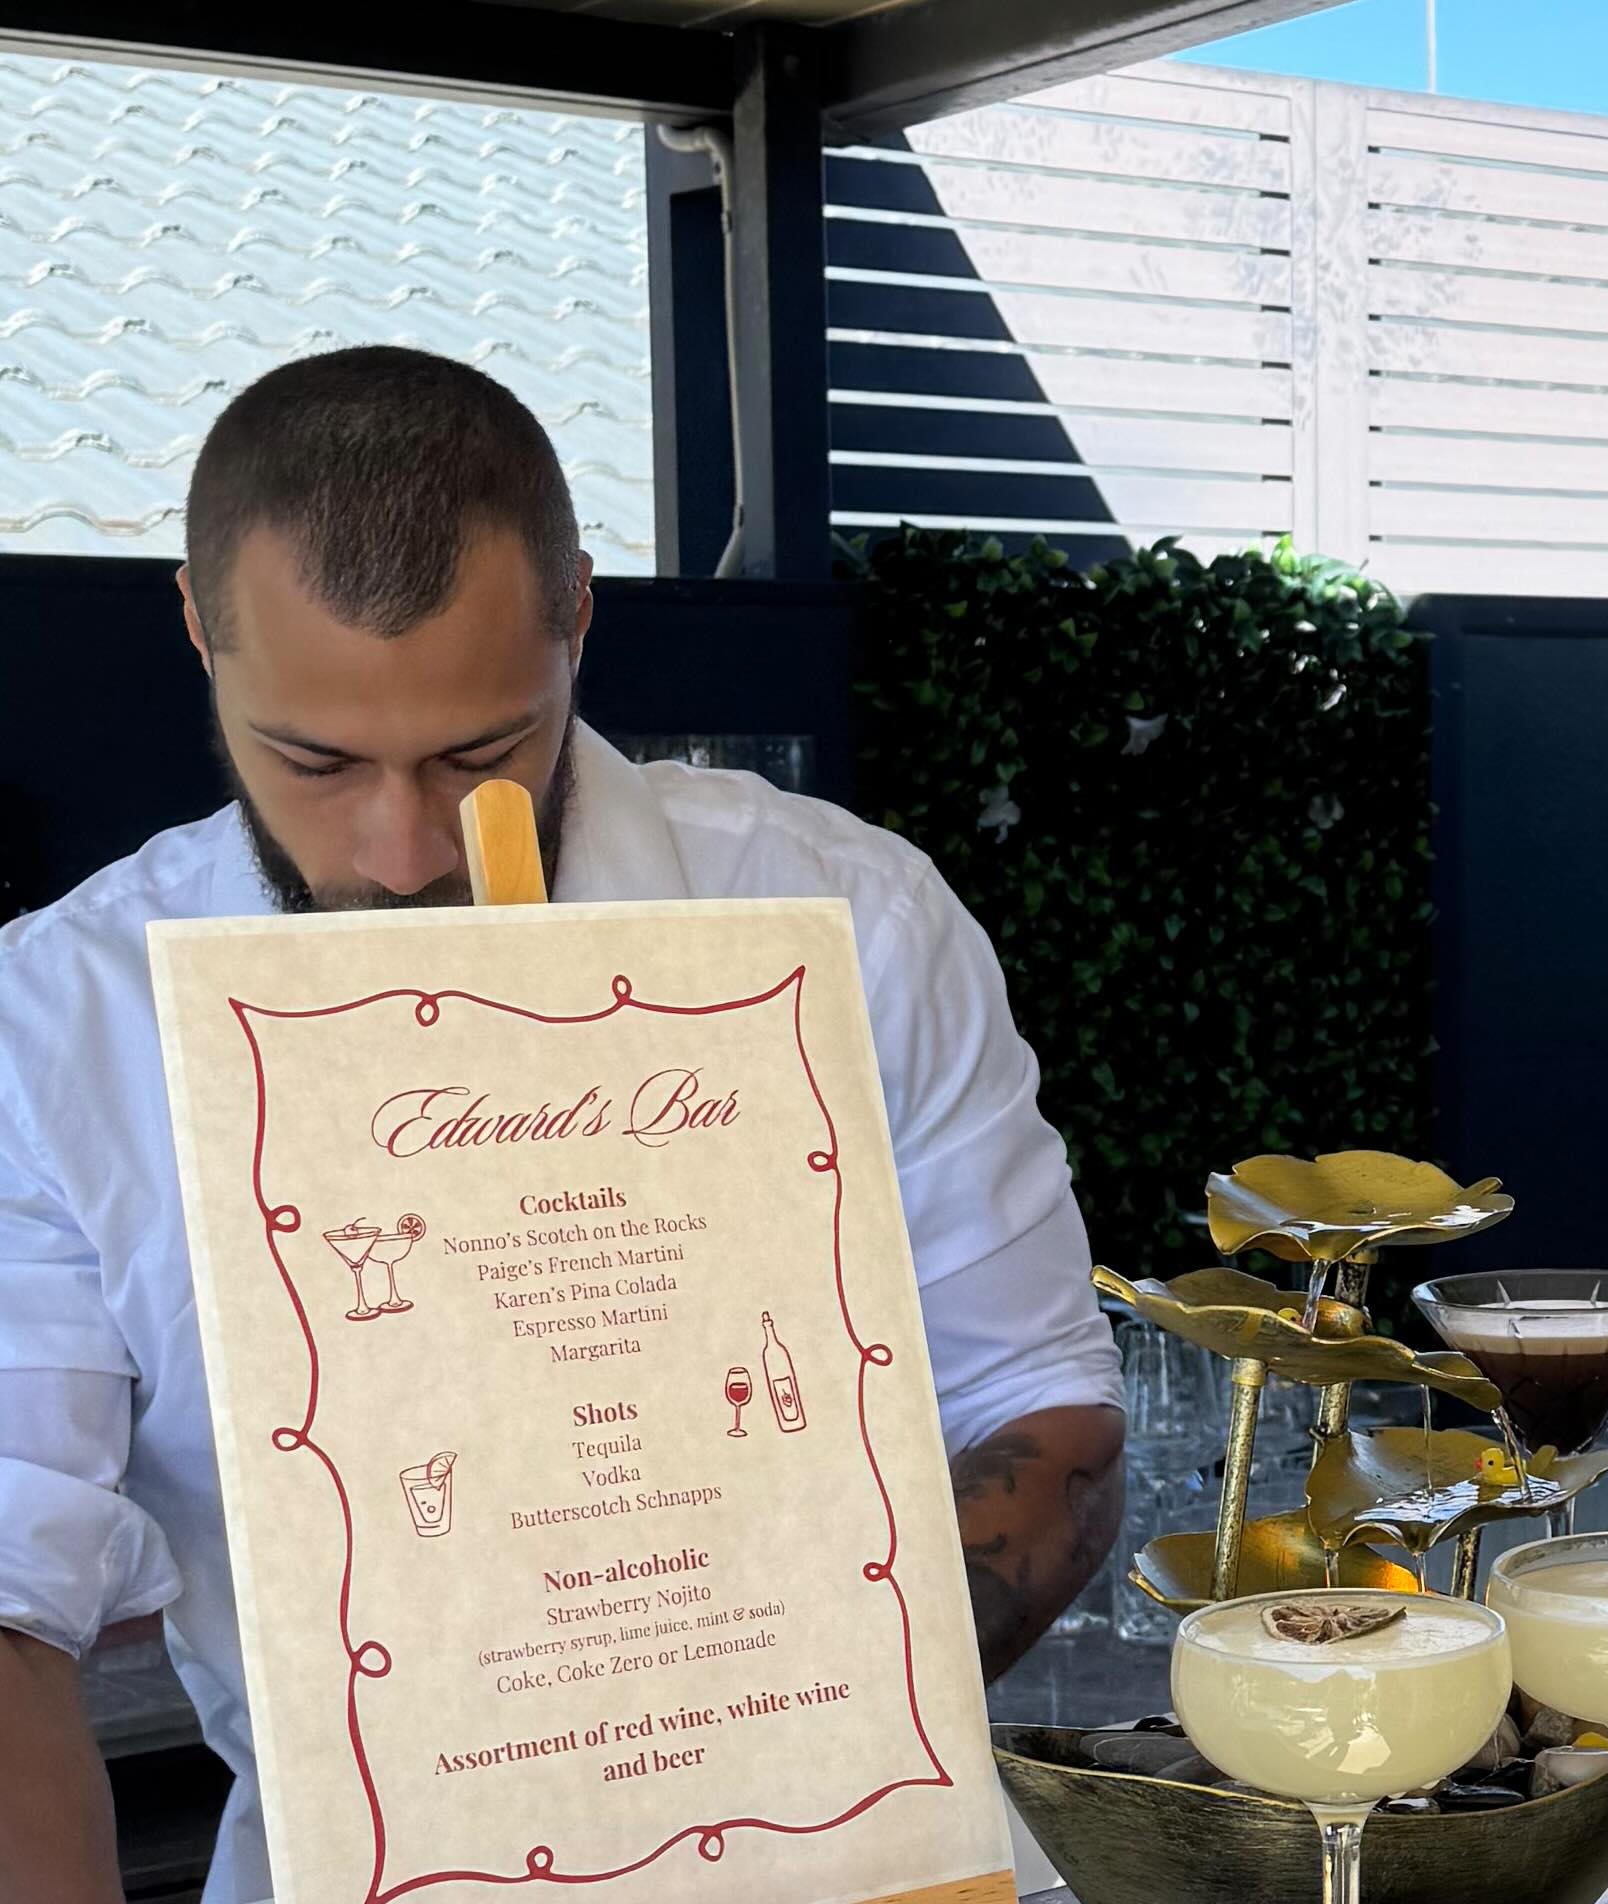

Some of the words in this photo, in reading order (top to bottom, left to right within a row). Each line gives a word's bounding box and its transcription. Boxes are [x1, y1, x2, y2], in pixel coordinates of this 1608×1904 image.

[371, 1085, 613, 1157] Edward's
[622, 1067, 740, 1148] Bar
[520, 1187, 627, 1215] Cocktails
[443, 1233, 522, 1256] Nonno's
[527, 1224, 588, 1248] Scotch
[594, 1226, 616, 1240] on
[620, 1221, 649, 1237] the
[654, 1214, 707, 1234] Rocks
[477, 1259, 543, 1282] Paige's
[548, 1252, 613, 1274] French
[618, 1244, 685, 1267] Martini
[494, 1286, 566, 1310] Karen's
[570, 1282, 611, 1300] Pina
[616, 1274, 677, 1295] Colada
[513, 1314, 596, 1339] Espresso
[601, 1305, 668, 1326] Martini
[551, 1338, 642, 1364] Margarita
[572, 1401, 638, 1427] Shots
[572, 1435, 643, 1462] Tequila
[582, 1465, 641, 1488] Vodka
[510, 1497, 632, 1530] Butterscotch
[636, 1484, 723, 1515] Schnapps
[543, 1548, 710, 1592] Non-alcoholic
[546, 1594, 651, 1626] Strawberry
[657, 1584, 711, 1610] Nojito
[478, 1638, 567, 1668] (strawberry
[570, 1631, 617, 1653] syrup,
[620, 1623, 651, 1641] lime
[654, 1616, 693, 1638] juice,
[696, 1610, 729, 1629] mint
[733, 1607, 746, 1622] &
[749, 1600, 785, 1621] soda)
[496, 1669, 553, 1695] Coke,
[557, 1662, 605, 1684] Coke
[610, 1654, 654, 1675] Zero
[659, 1650, 678, 1666] or
[683, 1631, 776, 1663] Lemonade
[434, 1730, 578, 1776] Assortment
[584, 1721, 607, 1747] of
[615, 1715, 653, 1743] red
[660, 1701, 723, 1734] wine,
[728, 1689, 790, 1722] white
[795, 1679, 850, 1707] wine
[603, 1752, 647, 1782] and
[653, 1745, 705, 1774] beer
